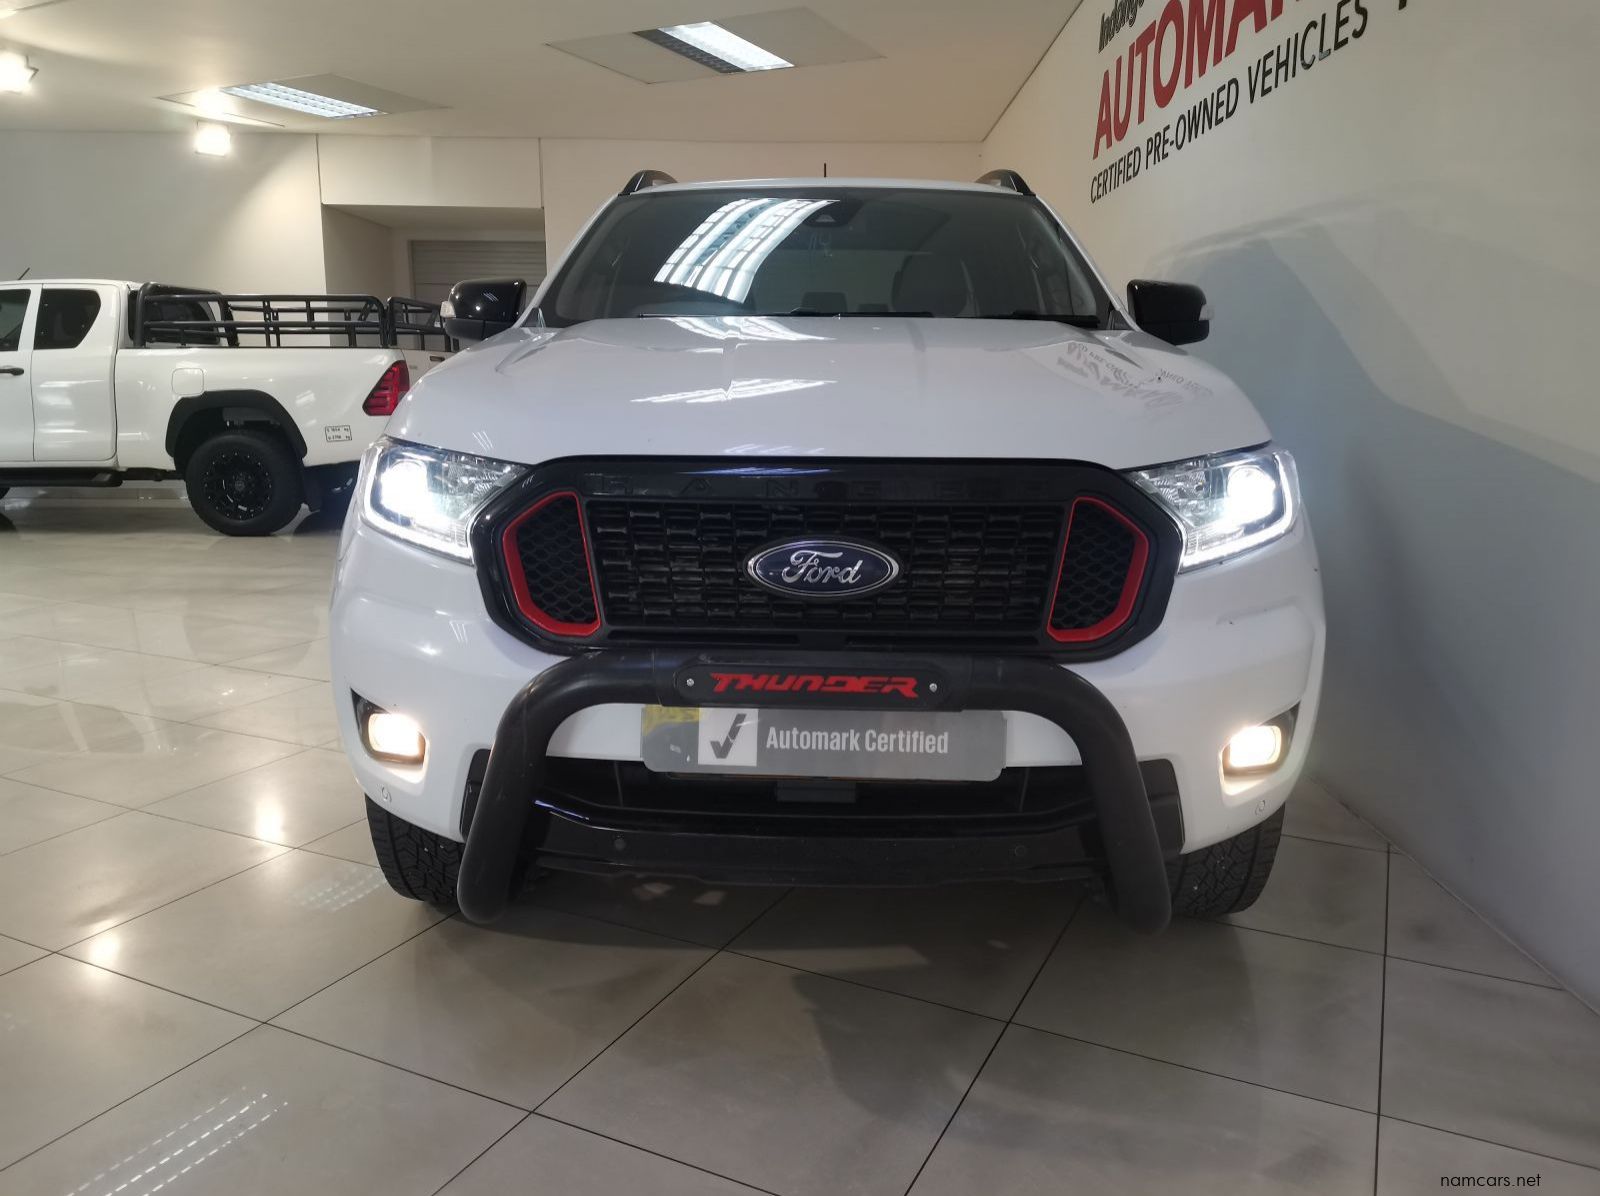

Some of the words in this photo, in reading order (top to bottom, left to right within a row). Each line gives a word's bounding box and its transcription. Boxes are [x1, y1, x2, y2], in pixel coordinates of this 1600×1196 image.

[1098, 0, 1144, 54] Indong
[1090, 146, 1142, 204] CERTIFIED
[1145, 77, 1240, 170] PRE-OWNED
[1247, 0, 1369, 104] VEHICLES
[1092, 0, 1283, 160] AUTOM
[781, 550, 864, 584] Ford
[710, 672, 919, 699] THUNDER
[766, 726, 860, 752] Automark
[864, 729, 949, 754] Certified
